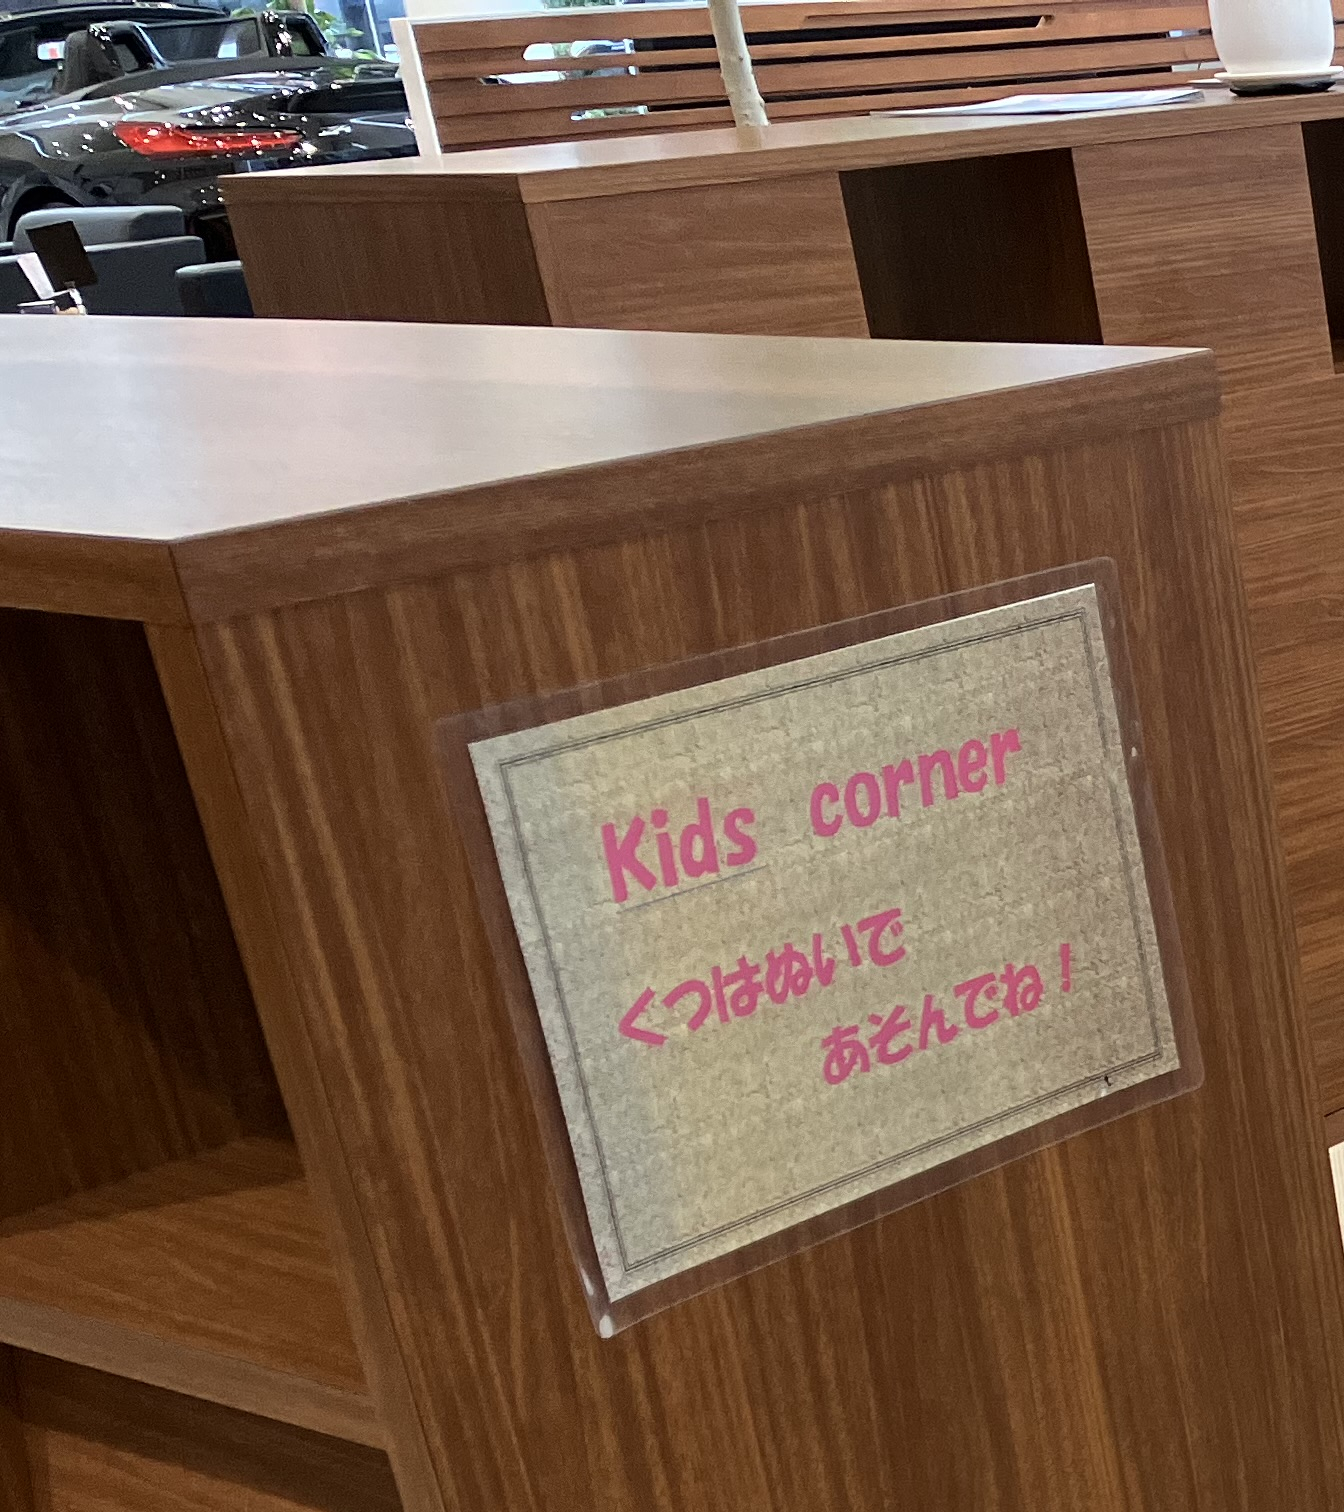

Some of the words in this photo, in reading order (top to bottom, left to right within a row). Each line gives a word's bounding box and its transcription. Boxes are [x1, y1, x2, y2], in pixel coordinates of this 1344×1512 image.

[602, 798, 757, 901] Kids
[810, 730, 1020, 837] corner
[620, 908, 906, 1046] くつはぬいで
[821, 942, 1073, 1084] あそんでね！
